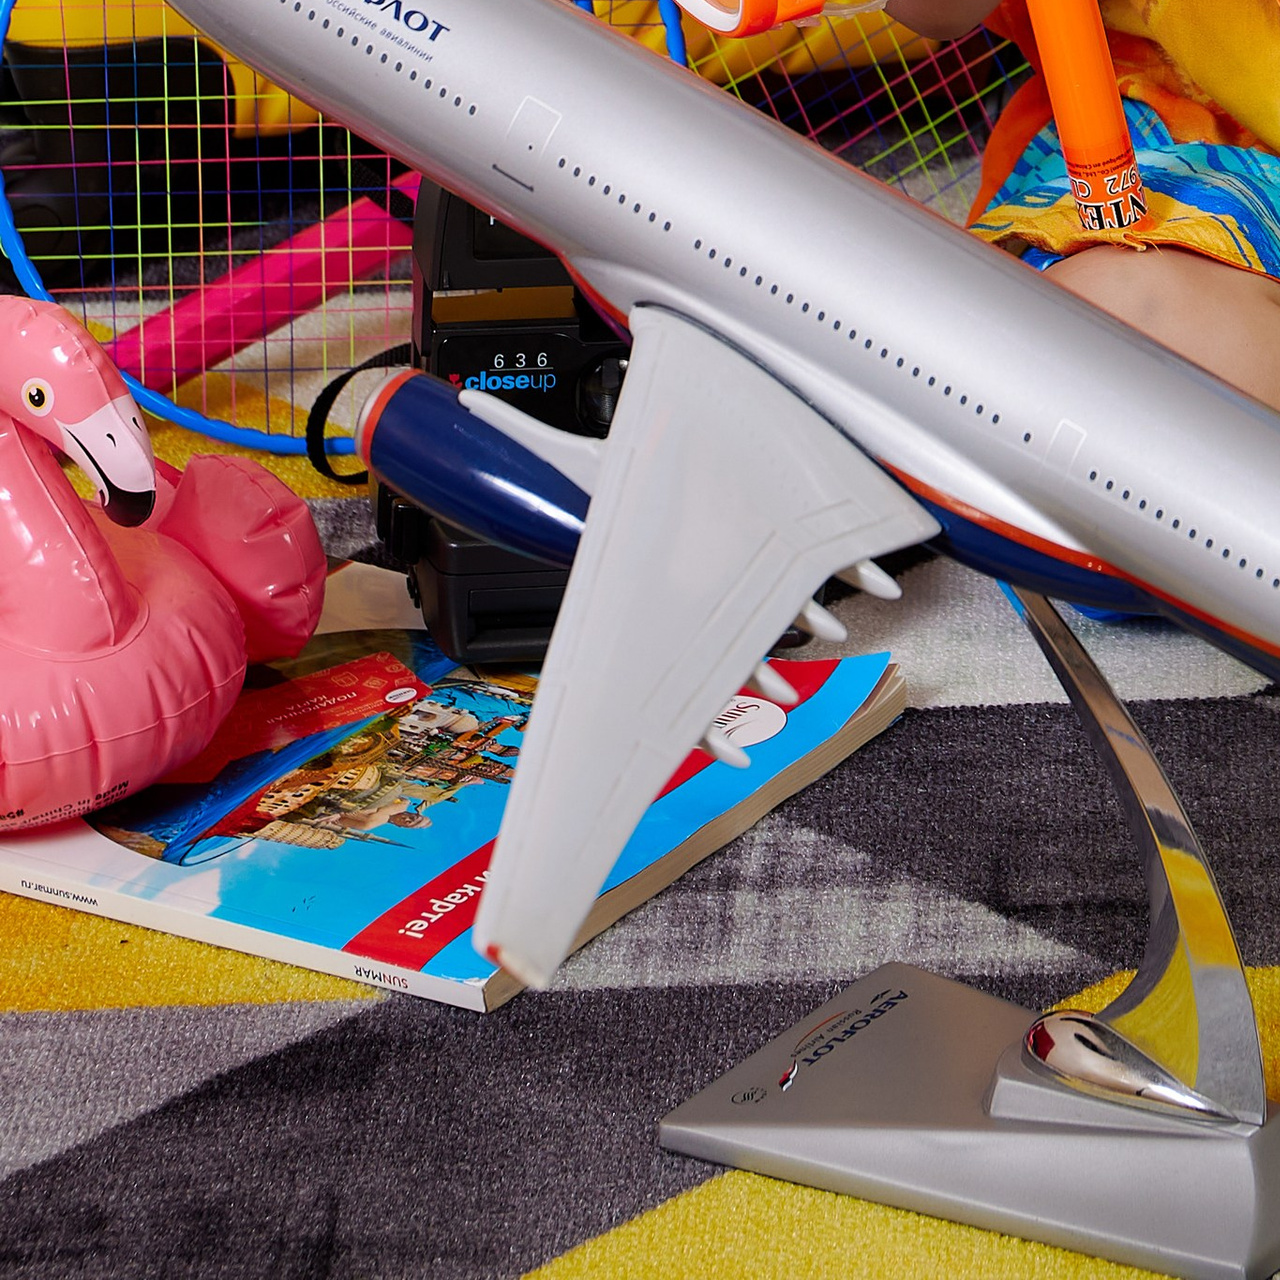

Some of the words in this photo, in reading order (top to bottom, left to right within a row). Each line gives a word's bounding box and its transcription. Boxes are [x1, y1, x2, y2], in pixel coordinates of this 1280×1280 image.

[379, 27, 434, 64] авиалинии
[465, 371, 556, 392] closeup
[95, 780, 129, 801] Made
[21, 880, 99, 907] www.sunmar.ru
[398, 884, 482, 939] карте!
[354, 965, 408, 989] SUNMAR
[802, 990, 908, 1067] AEROFLOT
[826, 1008, 862, 1033] Russian
